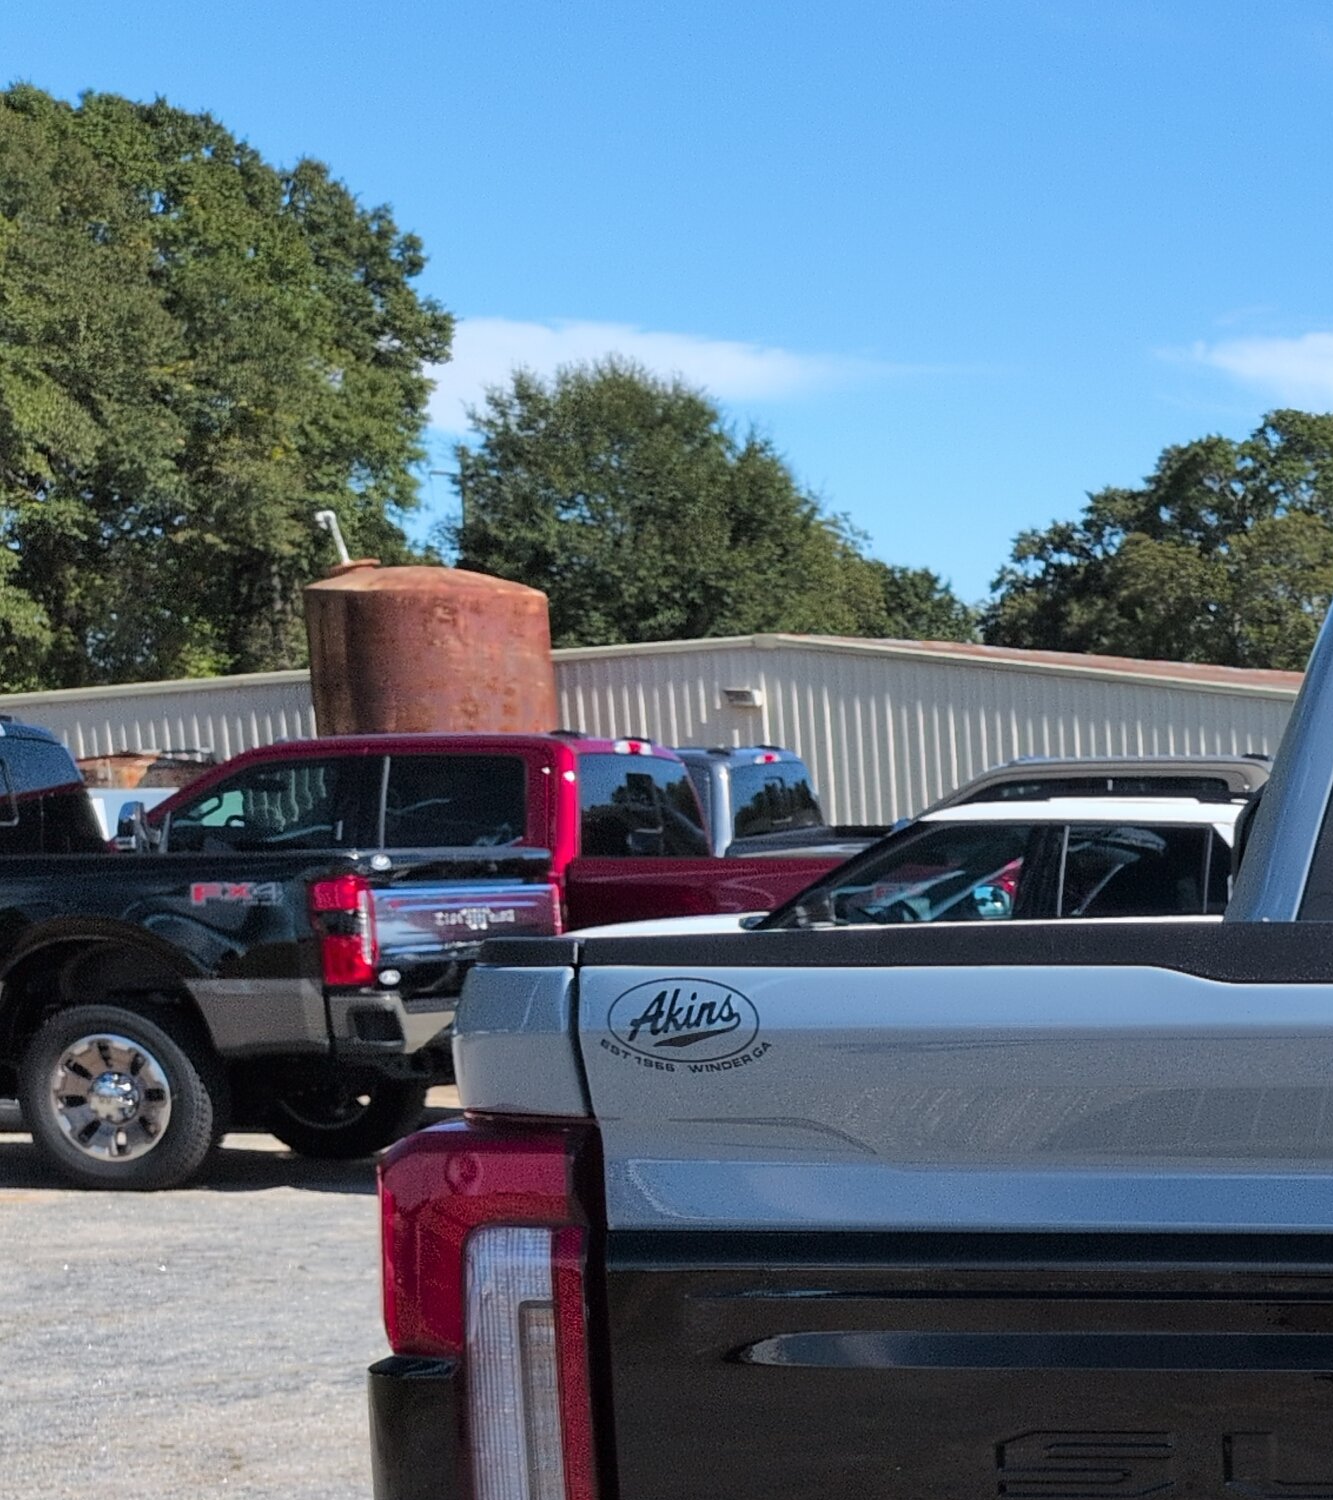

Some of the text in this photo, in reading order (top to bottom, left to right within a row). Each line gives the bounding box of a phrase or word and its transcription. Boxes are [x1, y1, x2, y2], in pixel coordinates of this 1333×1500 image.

[191, 881, 283, 907] FX4
[628, 988, 742, 1041] Akins
[600, 1038, 772, 1074] EST 1966 WINDER GA
